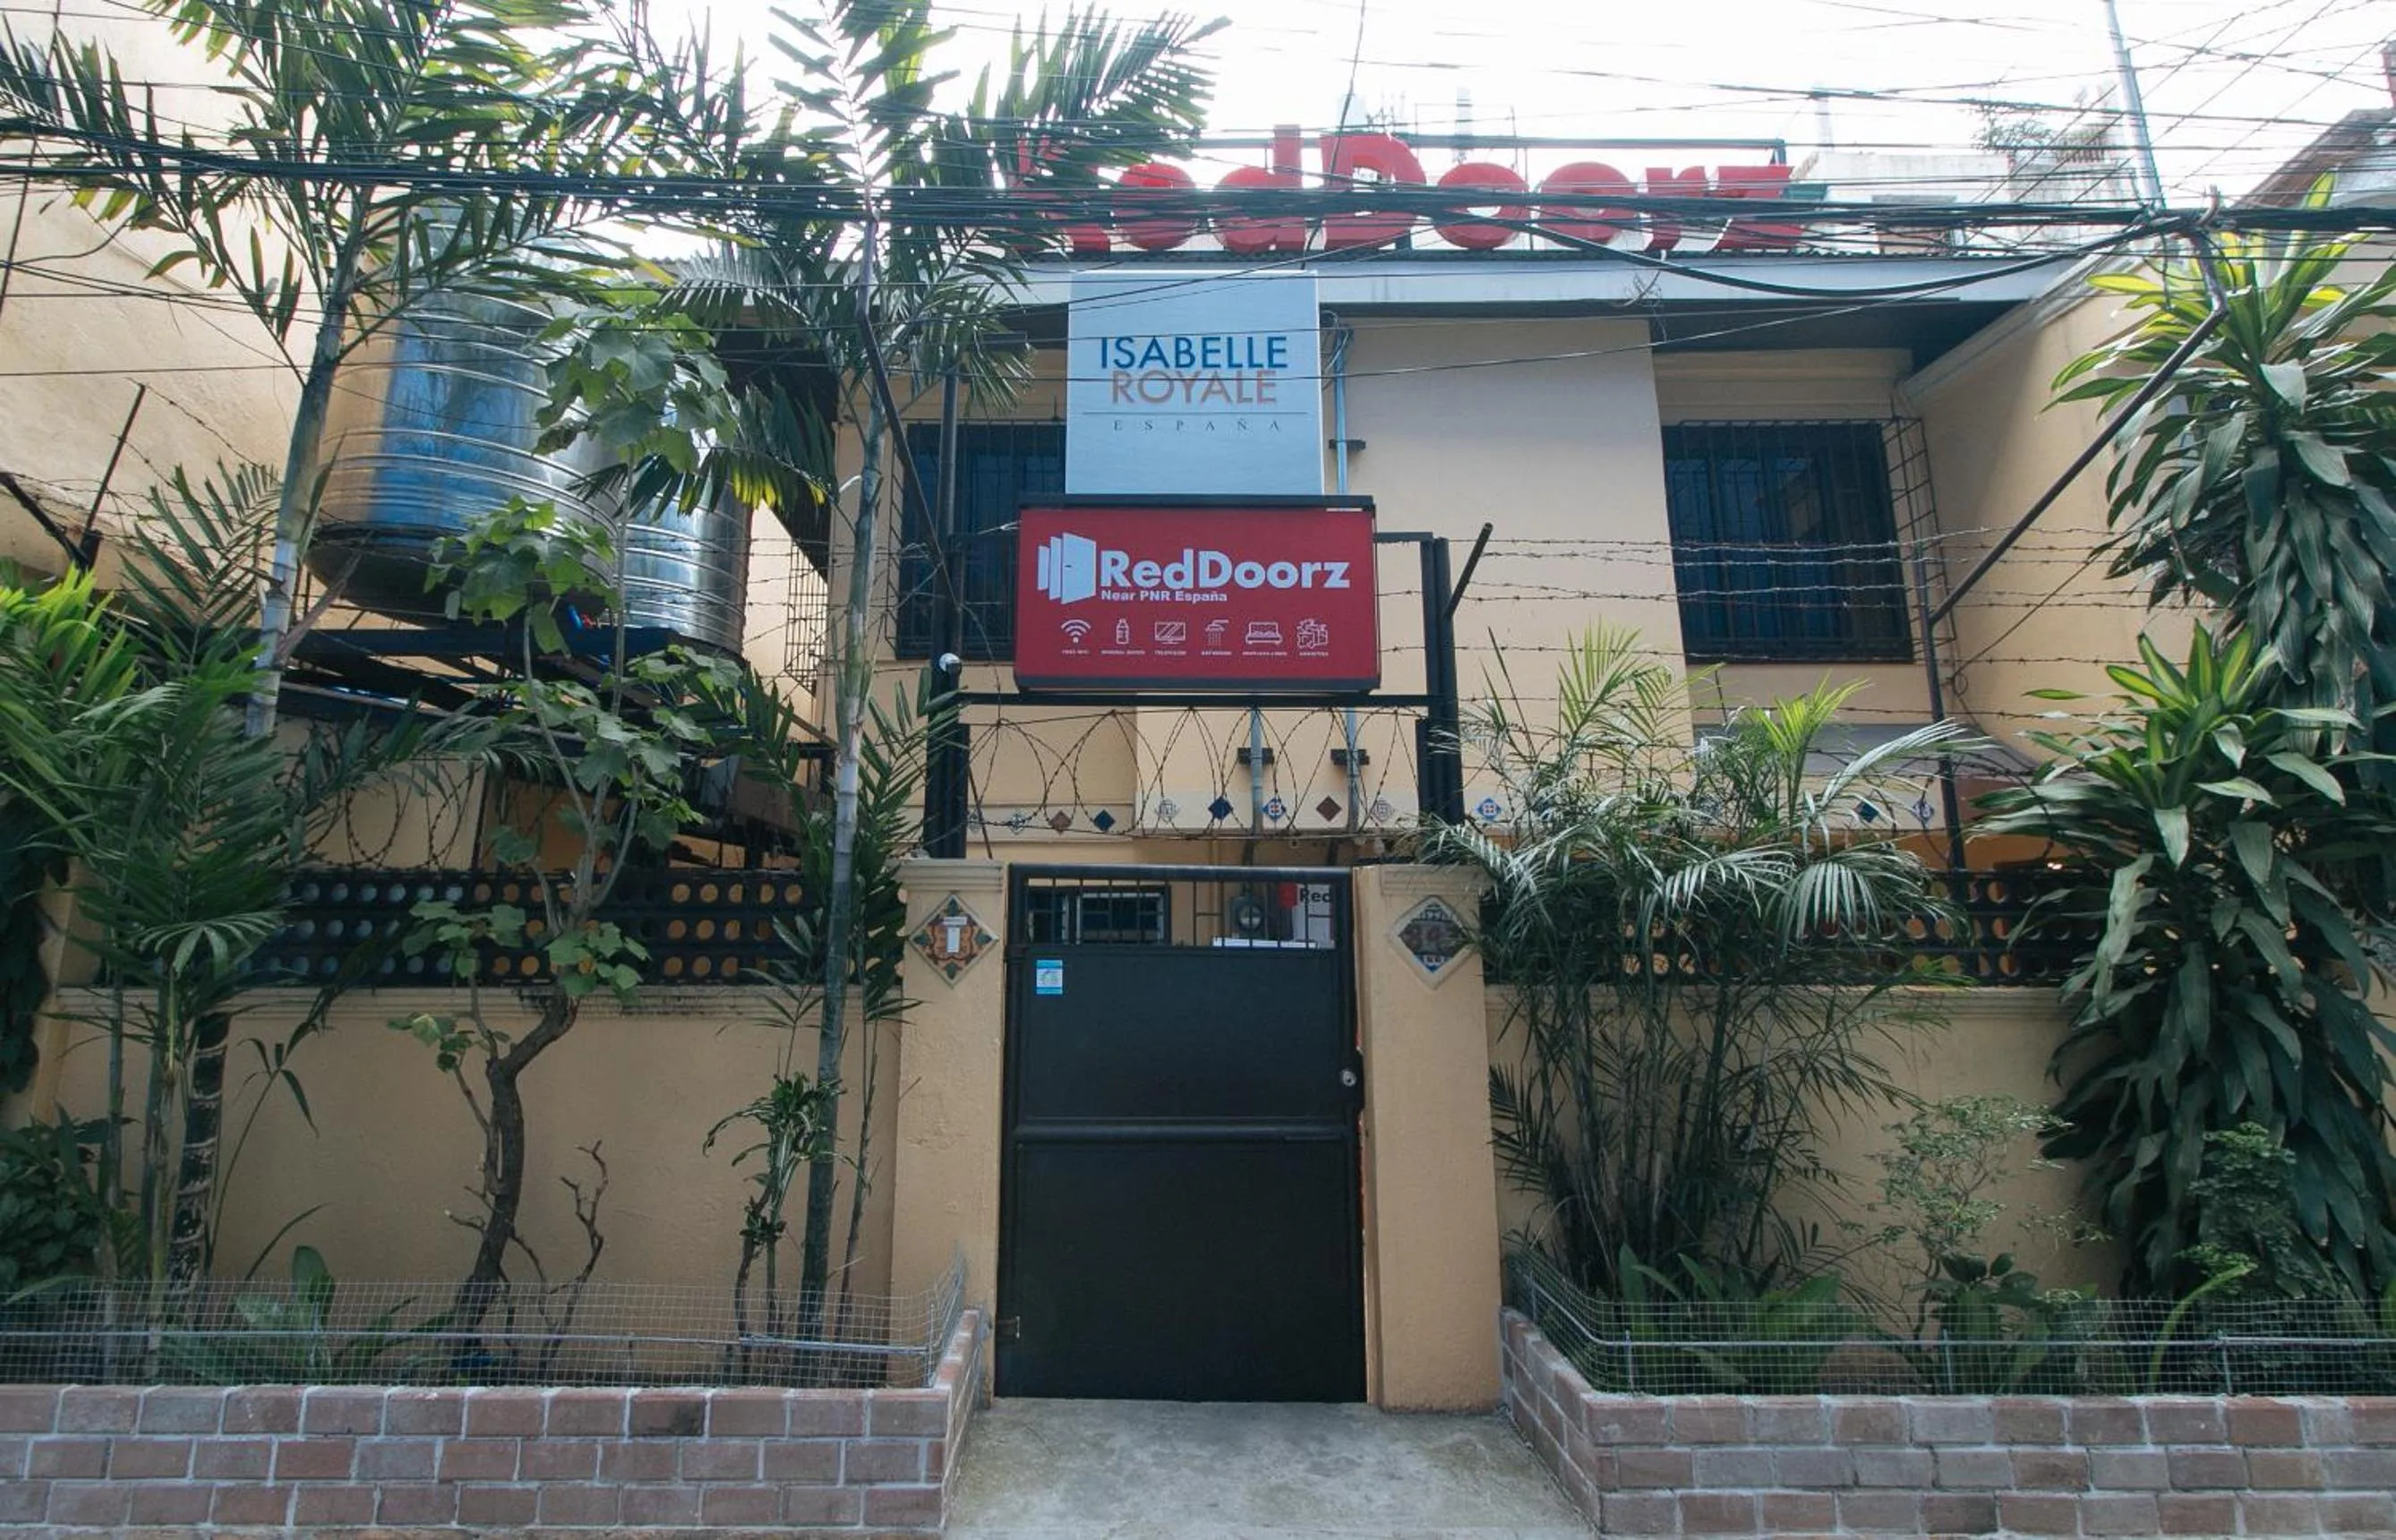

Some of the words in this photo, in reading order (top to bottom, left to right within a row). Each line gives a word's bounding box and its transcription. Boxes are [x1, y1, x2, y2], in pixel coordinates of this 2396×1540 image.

[1015, 124, 1803, 253] edDoorz
[1100, 336, 1288, 369] ISABELLE
[1111, 370, 1277, 404] ROYALE
[1114, 417, 1279, 432] ESPAÑA
[1101, 548, 1350, 589] RedDoorz
[1101, 590, 1135, 602] Near
[1140, 591, 1169, 602] PNR
[1175, 591, 1228, 604] España
